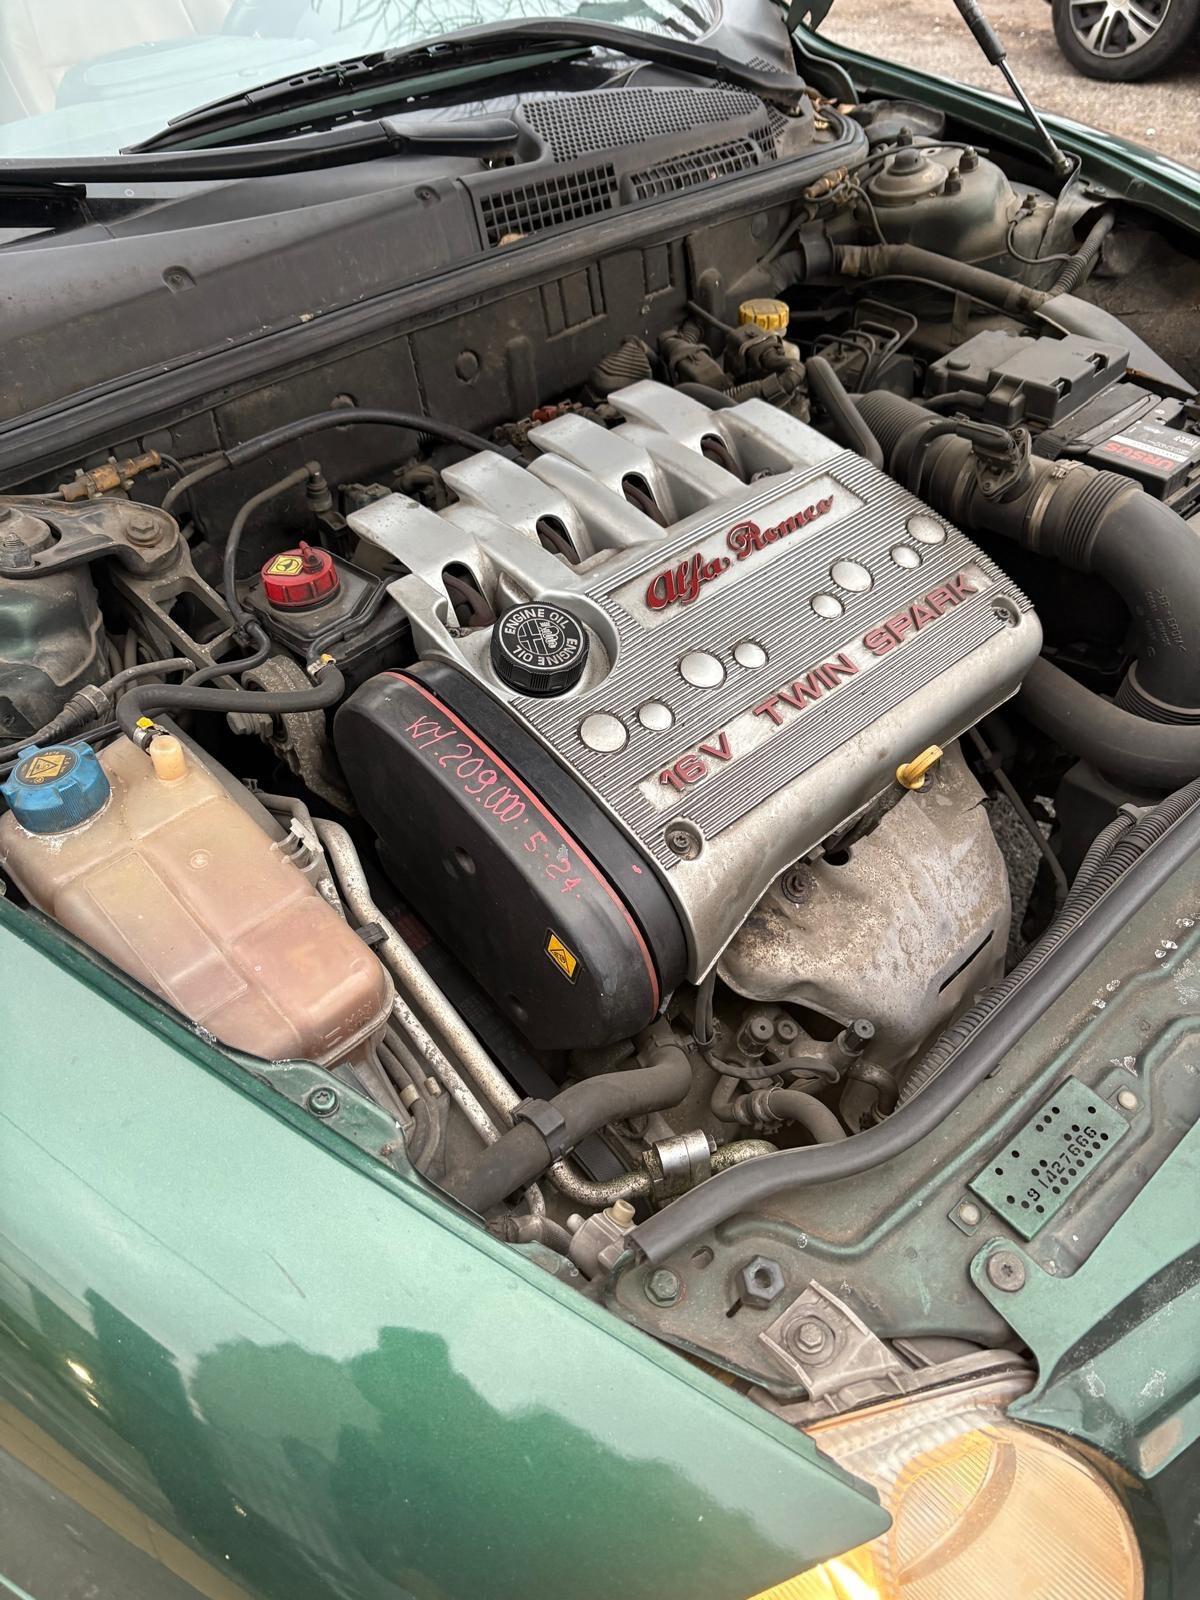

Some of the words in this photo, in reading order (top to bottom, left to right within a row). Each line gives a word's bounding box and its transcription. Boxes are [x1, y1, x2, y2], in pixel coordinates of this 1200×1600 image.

[1104, 442, 1174, 472] URSUS
[645, 552, 731, 610] Alfa
[727, 494, 834, 561] Romeo
[504, 608, 545, 635] ENGINE
[549, 611, 570, 630] OIL
[512, 644, 534, 663] OIL
[537, 637, 578, 666] ENGINE
[659, 731, 733, 793] 16V
[752, 652, 860, 727] TWIN
[863, 572, 980, 657] SPARK
